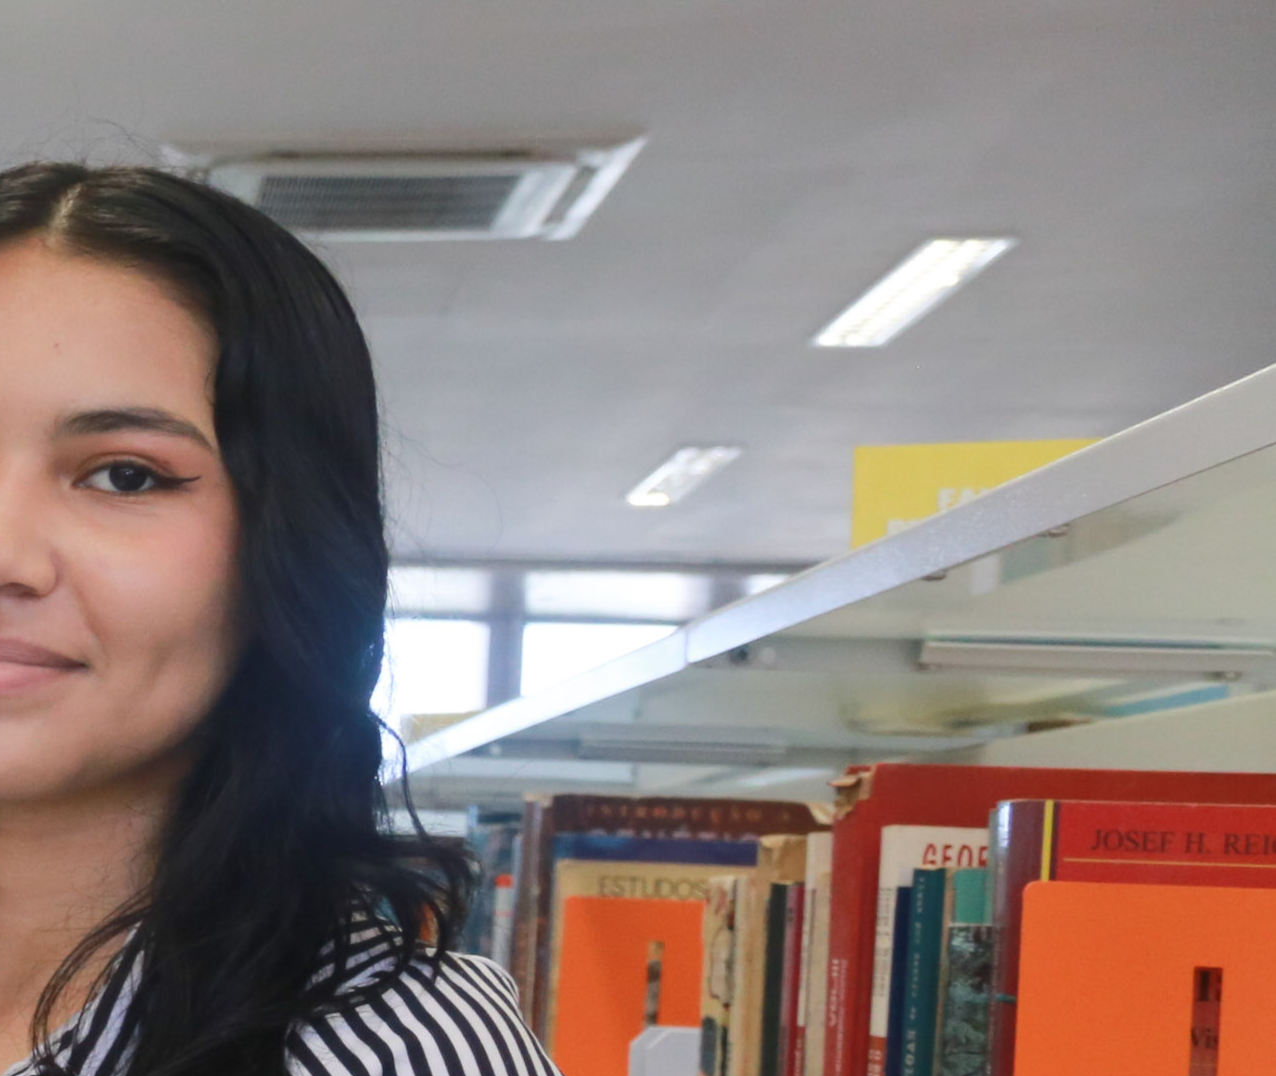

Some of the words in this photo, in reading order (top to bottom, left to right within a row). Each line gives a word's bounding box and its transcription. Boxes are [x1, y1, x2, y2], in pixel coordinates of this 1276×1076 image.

[1090, 829, 1175, 853] JOSEF
[1183, 832, 1210, 854] H.
[597, 875, 707, 899] ESTUDOS
